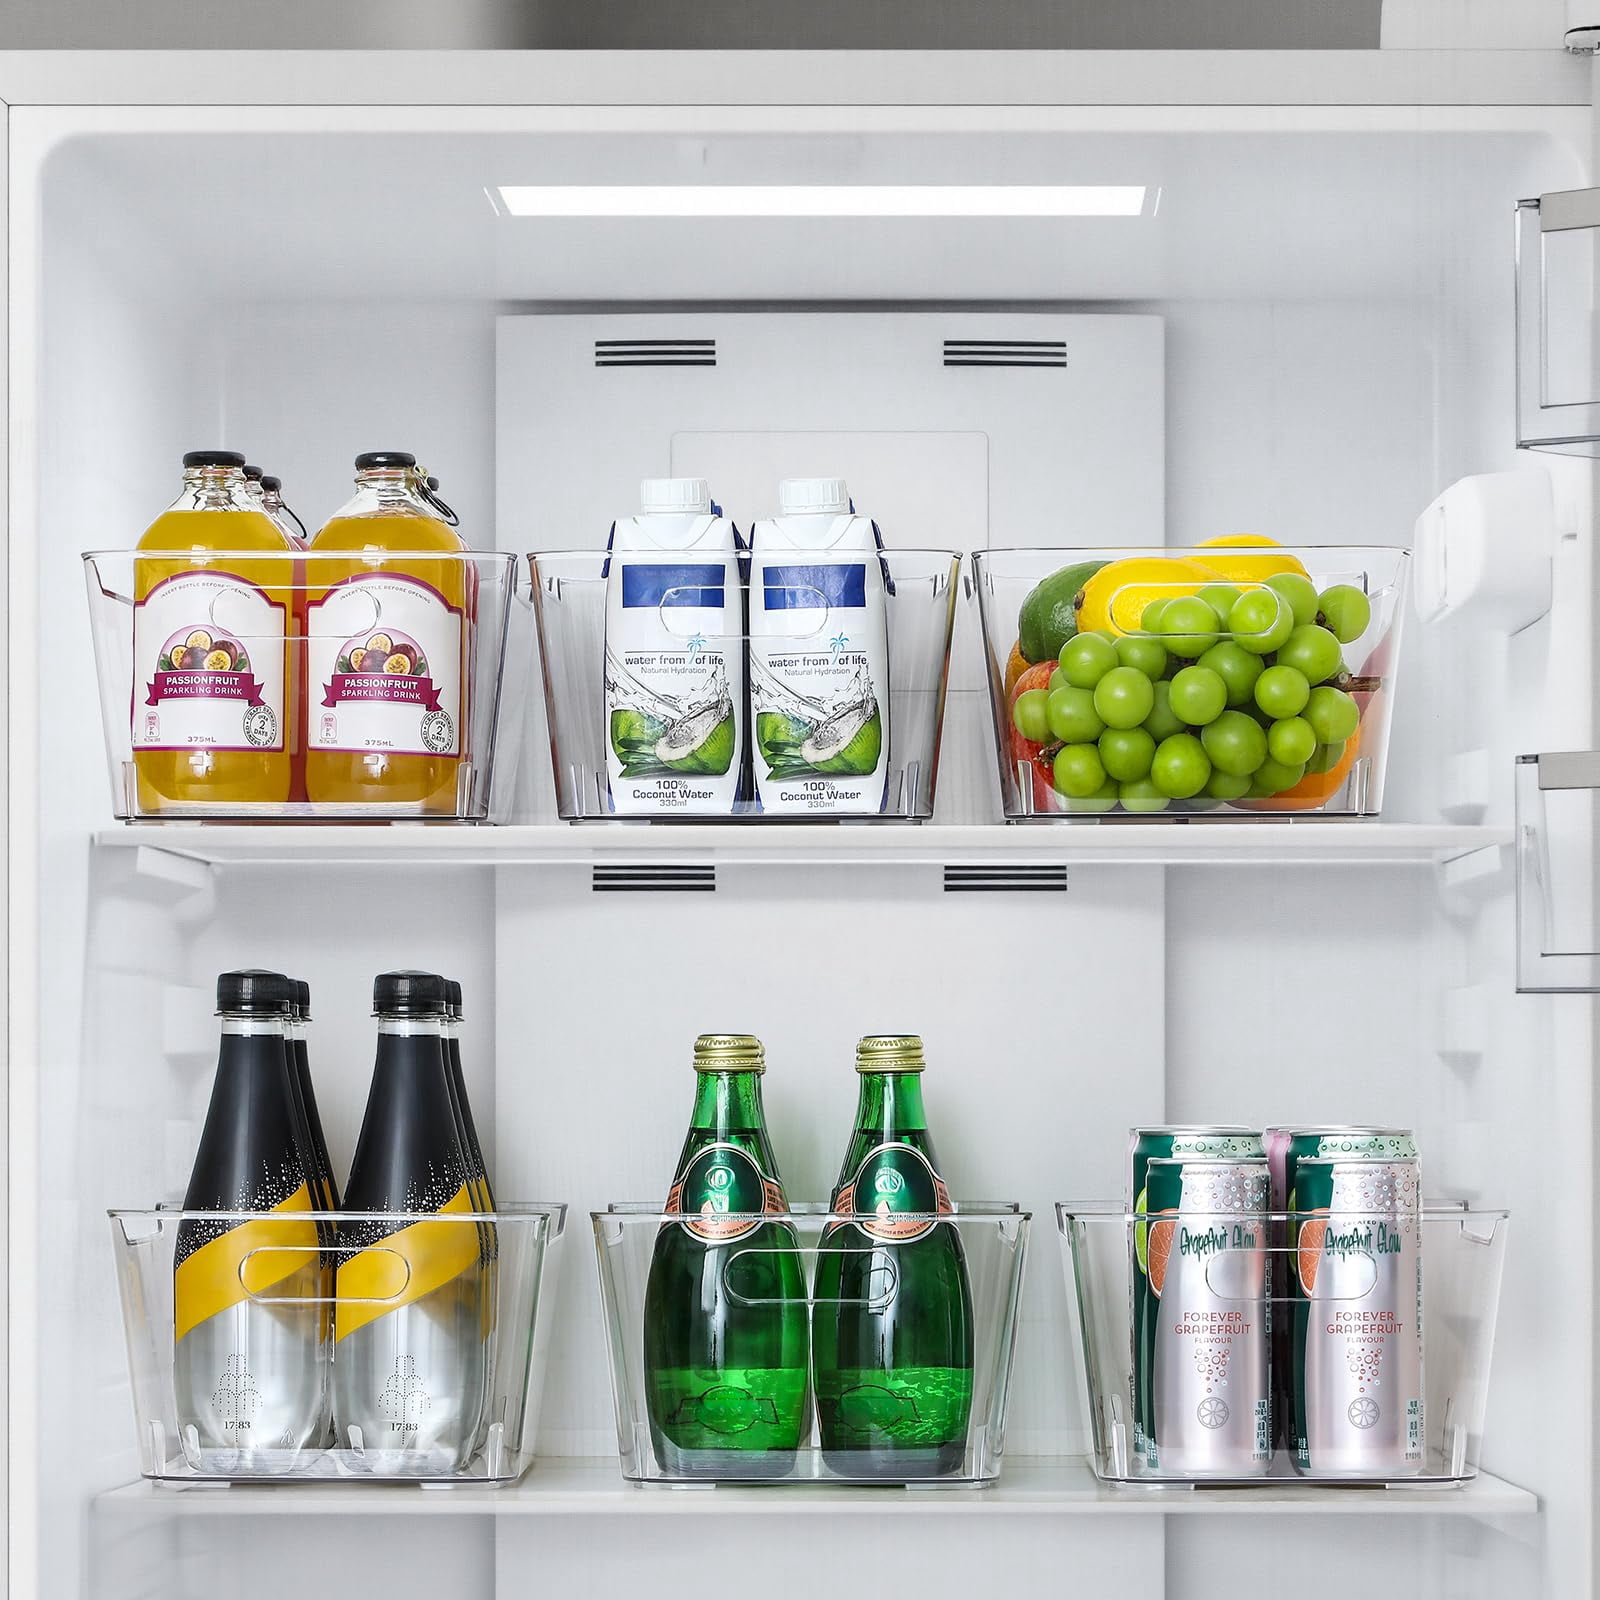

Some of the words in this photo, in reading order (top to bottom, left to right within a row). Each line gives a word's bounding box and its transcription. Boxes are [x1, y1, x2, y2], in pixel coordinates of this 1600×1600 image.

[625, 656, 655, 665] water
[659, 655, 685, 664] from
[695, 655, 705, 664] of
[709, 655, 724, 665] life
[768, 658, 799, 668] water
[803, 657, 829, 666] from
[838, 655, 849, 665] of
[852, 655, 867, 665] life
[670, 667, 707, 675] Hydration
[814, 668, 850, 676] Hydration
[166, 676, 240, 686] PASSIONFRUIT
[344, 679, 418, 690] PASSIONFRUIT
[163, 686, 212, 695] SPARKLING
[214, 687, 243, 695] DRINK
[341, 689, 390, 698] SPARKLING
[393, 691, 421, 700] DRINK
[259, 720, 266, 730] 2
[436, 725, 443, 735] 2
[364, 739, 394, 747] 375ML
[655, 780, 688, 790] 100%
[803, 782, 836, 791] 100%
[632, 790, 676, 799] Coconut
[679, 790, 714, 799] Water
[780, 792, 824, 801] Coconut
[827, 791, 861, 800] Water
[659, 799, 687, 807] 330ml
[1183, 1312, 1242, 1322] FOREVER
[1335, 1312, 1394, 1321] FOREVER
[1174, 1324, 1251, 1334] GRAPEFRUIT
[1326, 1323, 1403, 1334] GRAPEFRUIT
[1346, 1336, 1385, 1344] FLAVOUR
